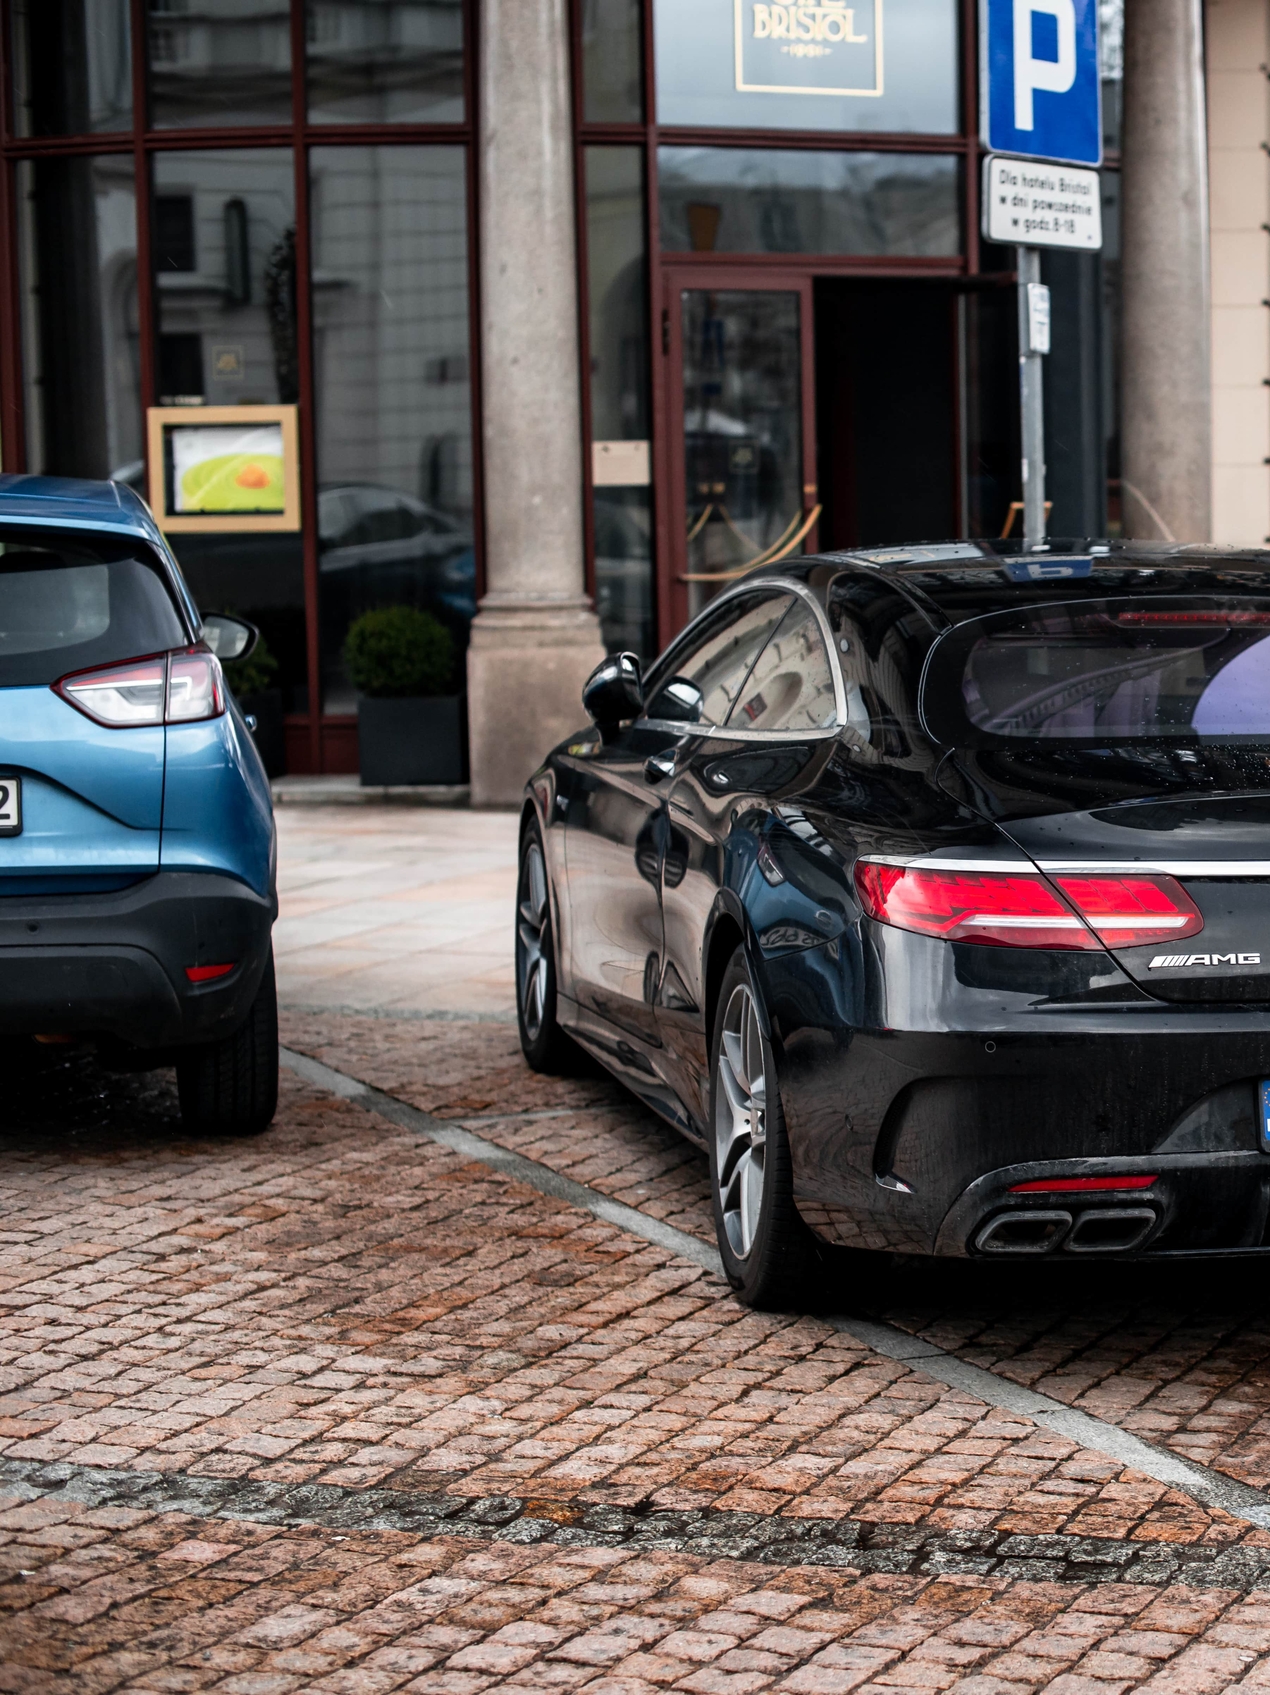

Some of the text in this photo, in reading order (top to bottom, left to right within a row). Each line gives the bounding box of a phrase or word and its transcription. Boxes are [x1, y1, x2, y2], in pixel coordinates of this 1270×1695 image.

[753, 4, 868, 43] BRISTOL
[1013, 0, 1076, 131] P
[1000, 169, 1091, 195] Dla hotelu Bristol
[999, 193, 1092, 215] w dni powszednie
[1012, 218, 1020, 227] w
[1185, 953, 1261, 966] AMG
